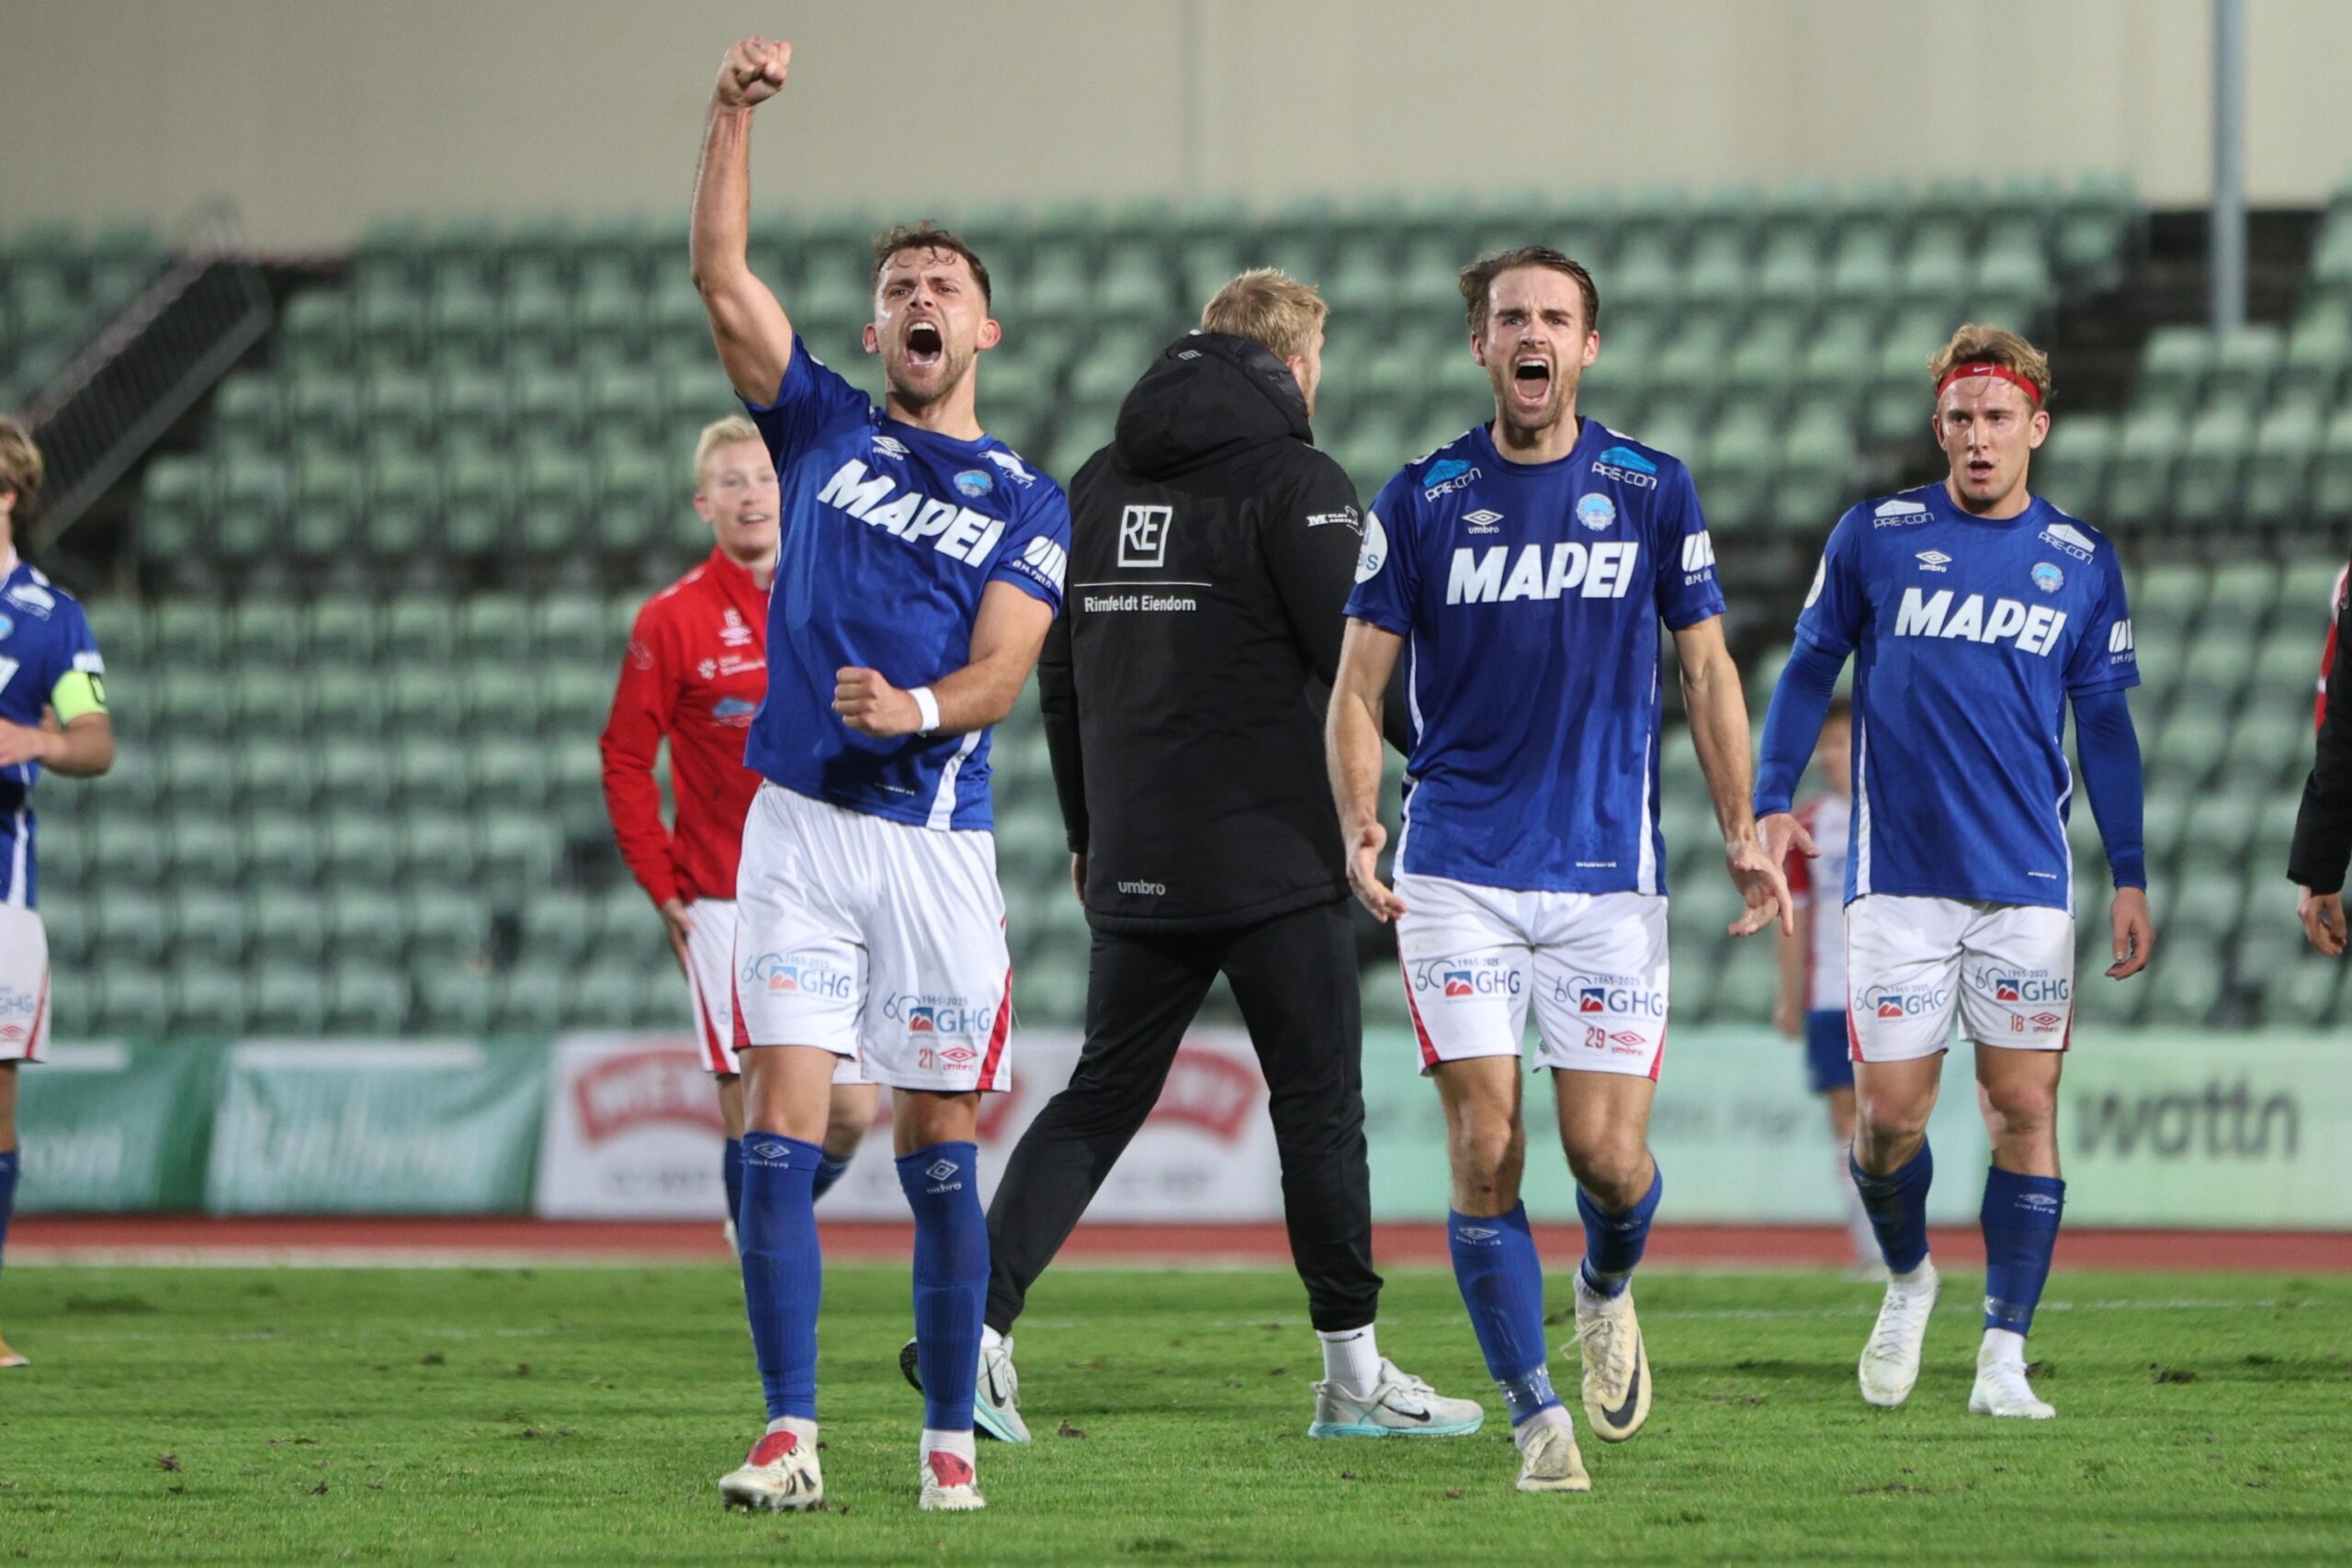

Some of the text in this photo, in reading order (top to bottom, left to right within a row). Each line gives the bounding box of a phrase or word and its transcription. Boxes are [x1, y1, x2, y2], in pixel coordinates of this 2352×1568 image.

[1424, 468, 1482, 502] PRE-CON
[1591, 462, 1657, 491] PRE-CON
[816, 458, 1006, 568] MAPEI
[1873, 513, 1935, 529] PRE-CON
[1118, 505, 1162, 551] RE
[1468, 525, 1500, 535] umbro
[2038, 531, 2095, 565] PRE-CON
[1446, 542, 1639, 605] MAPEI
[1919, 564, 1947, 573] umbro
[1084, 595, 1196, 613] Rimfeldt Eiendom
[1894, 587, 2067, 658] MAPEI
[1117, 879, 1166, 896] umbro
[800, 970, 851, 998] GHG
[1476, 970, 1521, 995] GHG
[2022, 978, 2069, 1001] GHG
[922, 995, 968, 1007] 1965-2025
[1608, 988, 1663, 1017] GHG
[936, 1008, 990, 1033] GHG
[2010, 1013, 2025, 1032] 18
[1585, 1026, 1606, 1049] 29
[919, 1048, 975, 1071] 21 umbro
